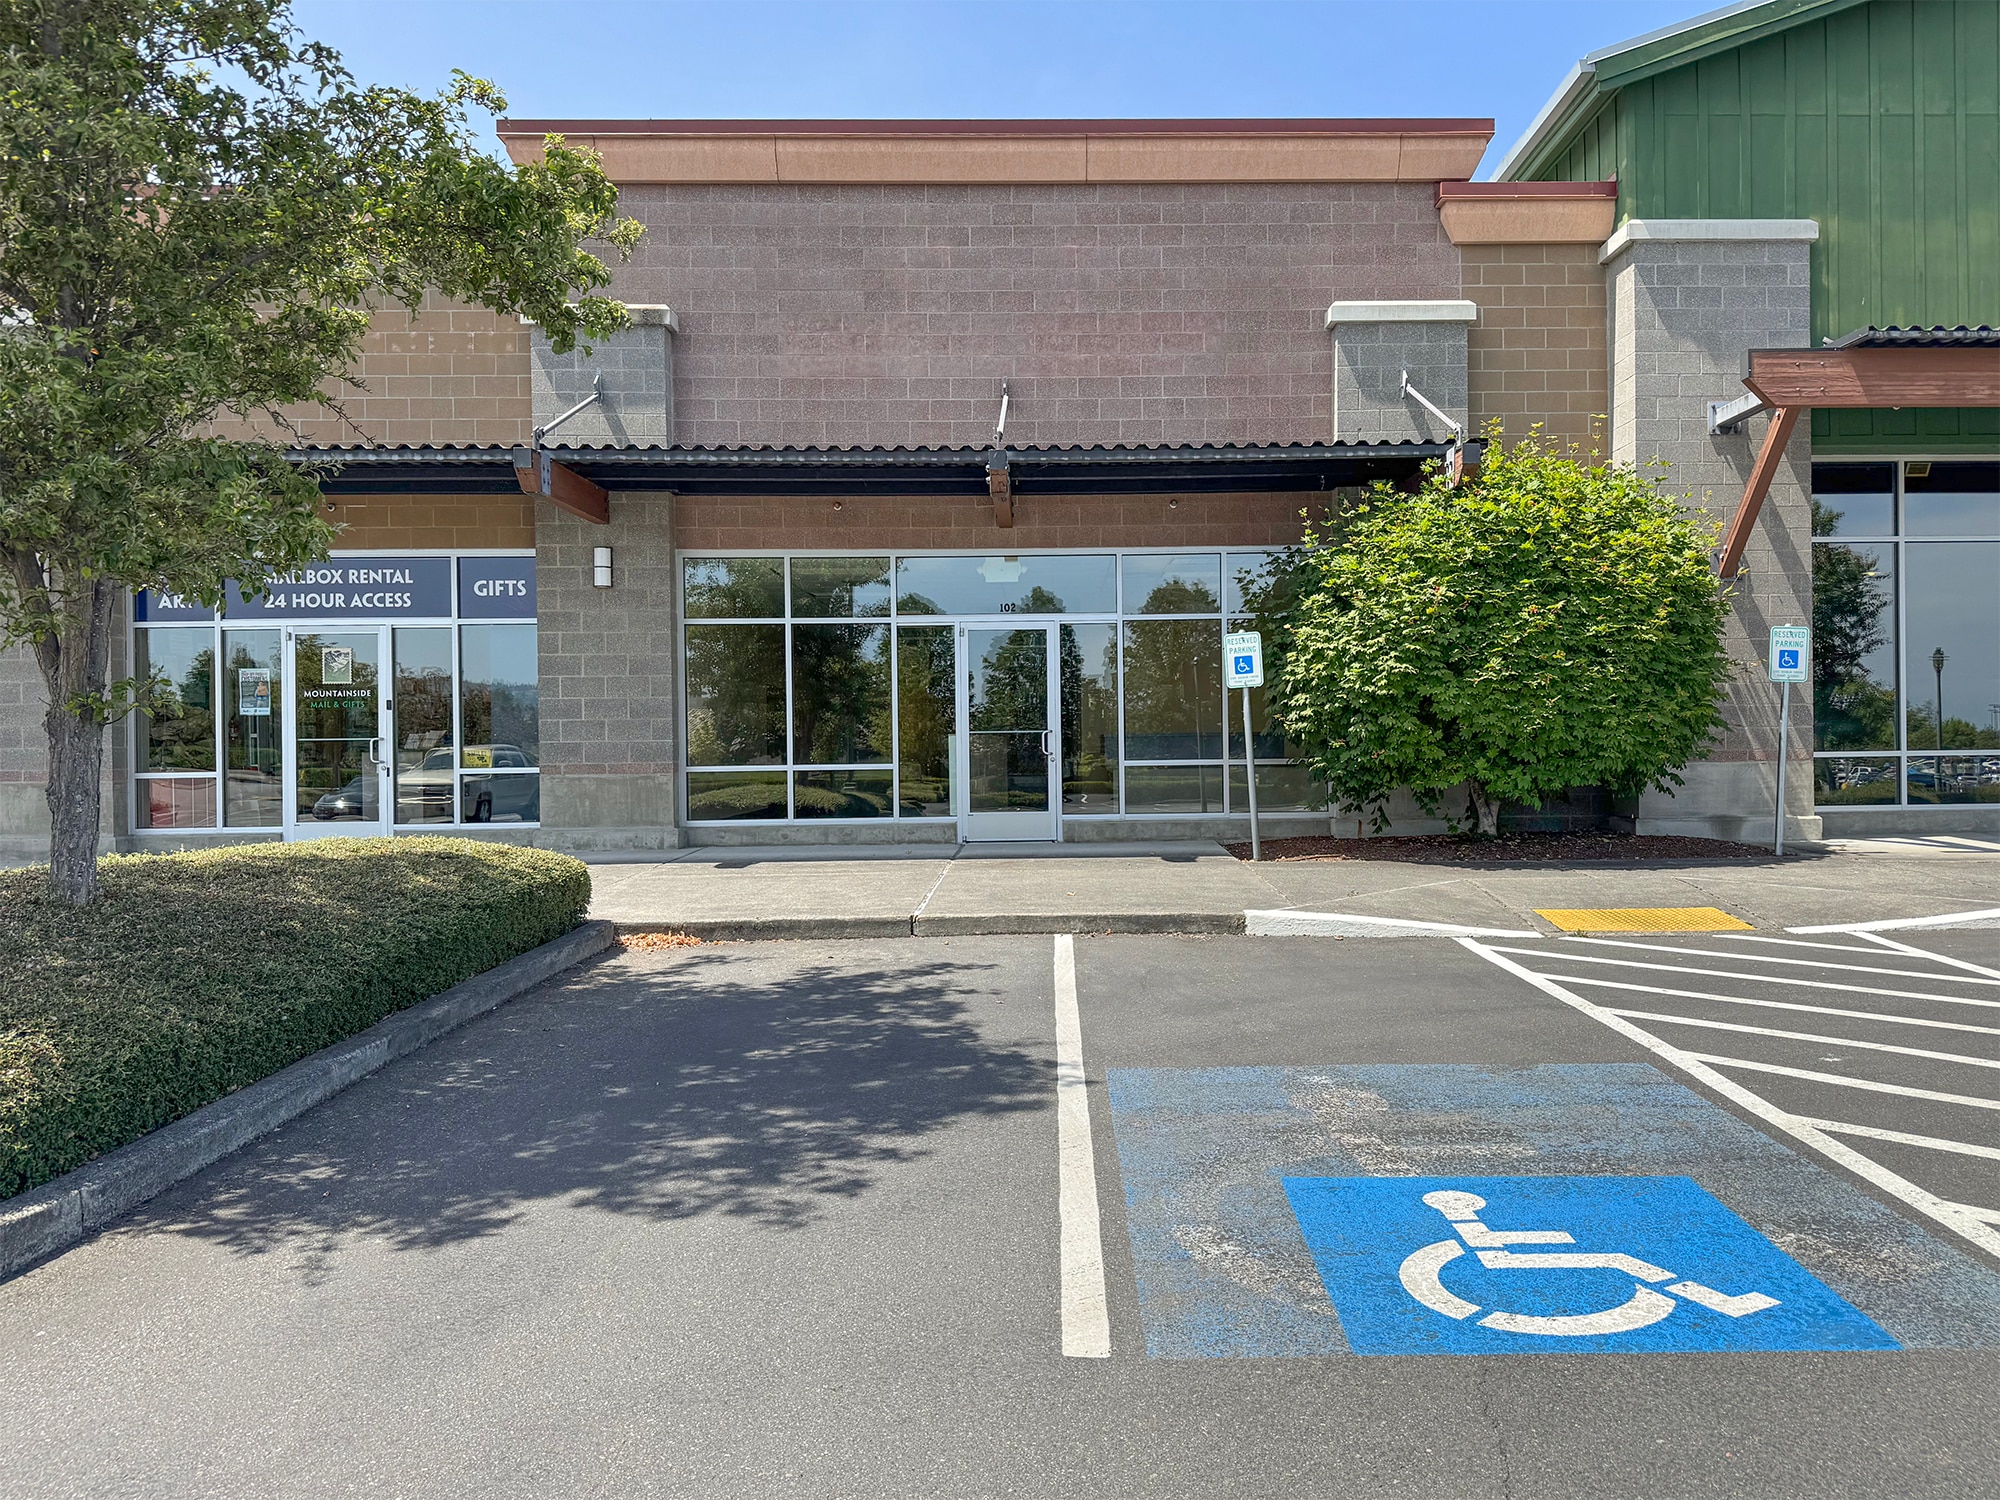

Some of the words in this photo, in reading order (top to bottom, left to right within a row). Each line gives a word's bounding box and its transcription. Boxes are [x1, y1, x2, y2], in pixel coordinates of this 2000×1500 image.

[349, 569, 414, 584] RENTAL
[473, 579, 527, 597] GIFTS
[158, 592, 194, 609] AR
[264, 593, 287, 609] 24
[292, 593, 346, 608] HOUR
[350, 592, 412, 608] ACCESS
[1000, 602, 1016, 613] 102
[1774, 630, 1806, 639] RESERVED
[1227, 636, 1258, 646] RESERVED
[1775, 639, 1804, 648] PARKING
[1229, 645, 1257, 655] PARKING
[303, 689, 372, 698] MOUNTAINSIDE
[310, 701, 331, 709] MAIL
[333, 701, 340, 709] &
[342, 700, 366, 709] GIFTS
